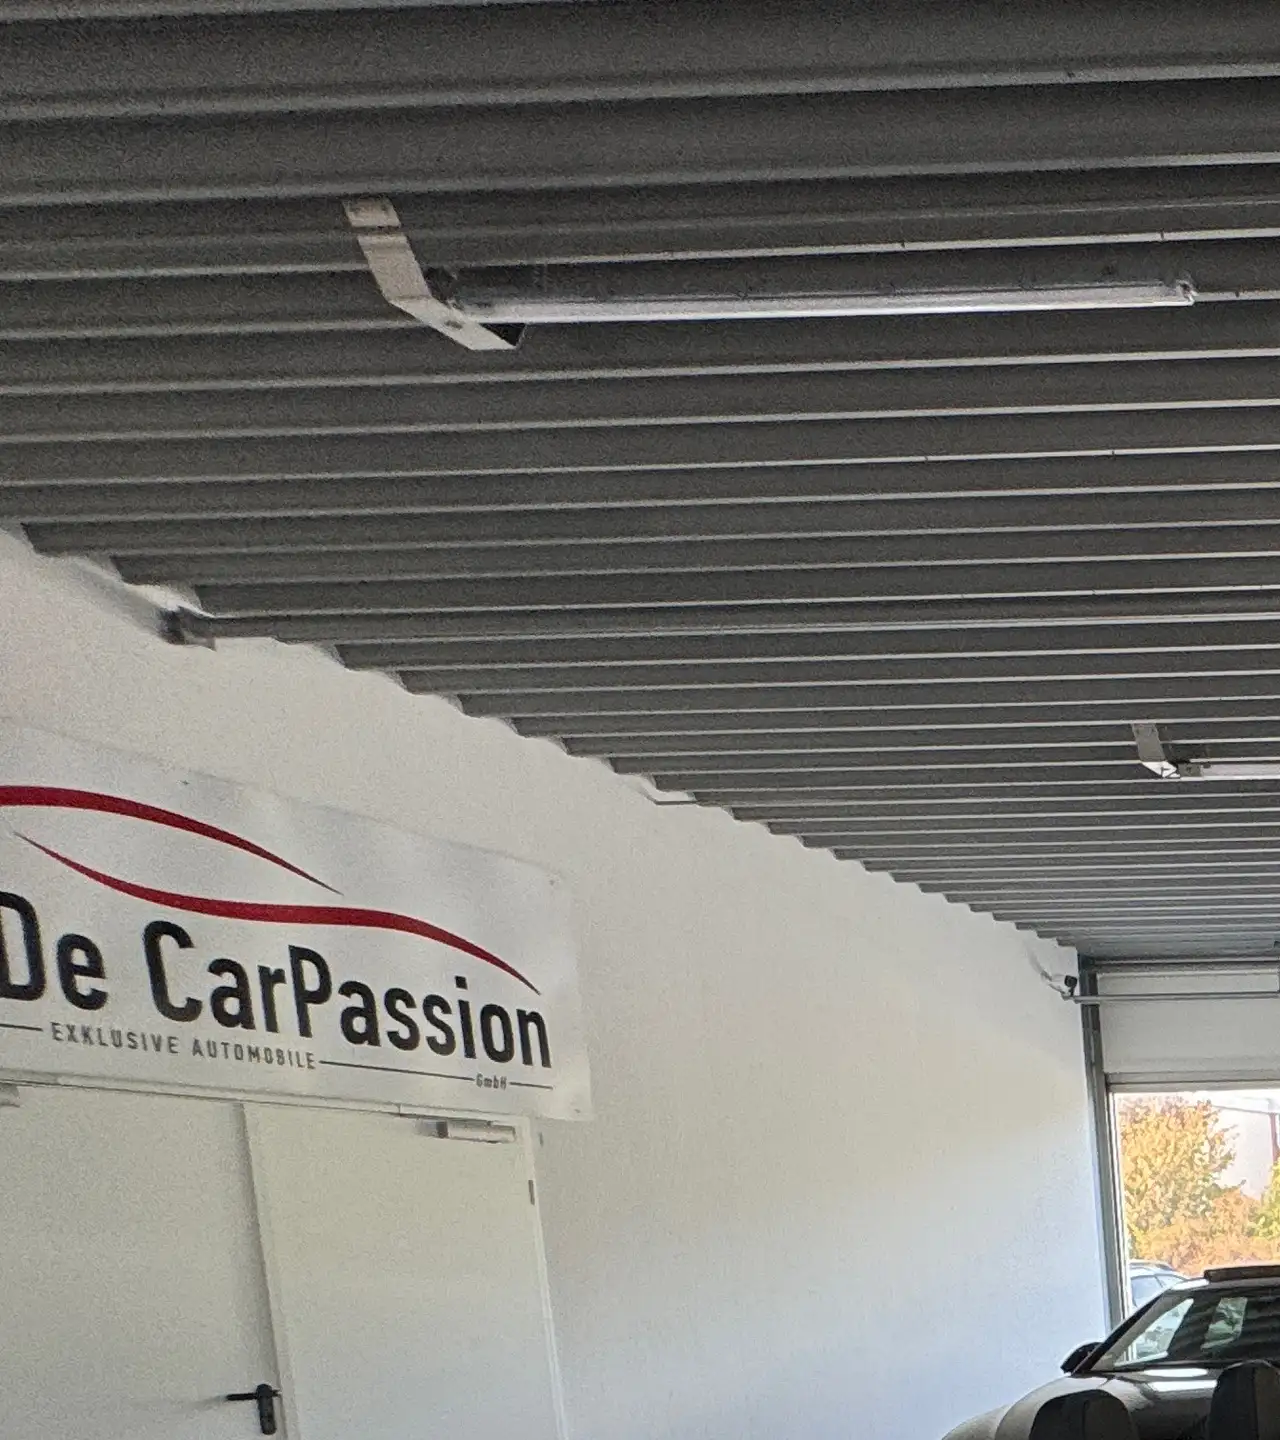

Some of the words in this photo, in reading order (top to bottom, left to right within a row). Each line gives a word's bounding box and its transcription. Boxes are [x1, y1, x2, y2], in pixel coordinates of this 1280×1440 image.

[0, 891, 108, 1010] De
[143, 920, 552, 1069] CarPassion
[50, 1022, 180, 1055] EXKLUSIVE
[191, 1038, 317, 1070] AUTOMOBILE
[476, 1073, 508, 1090] GmbH
